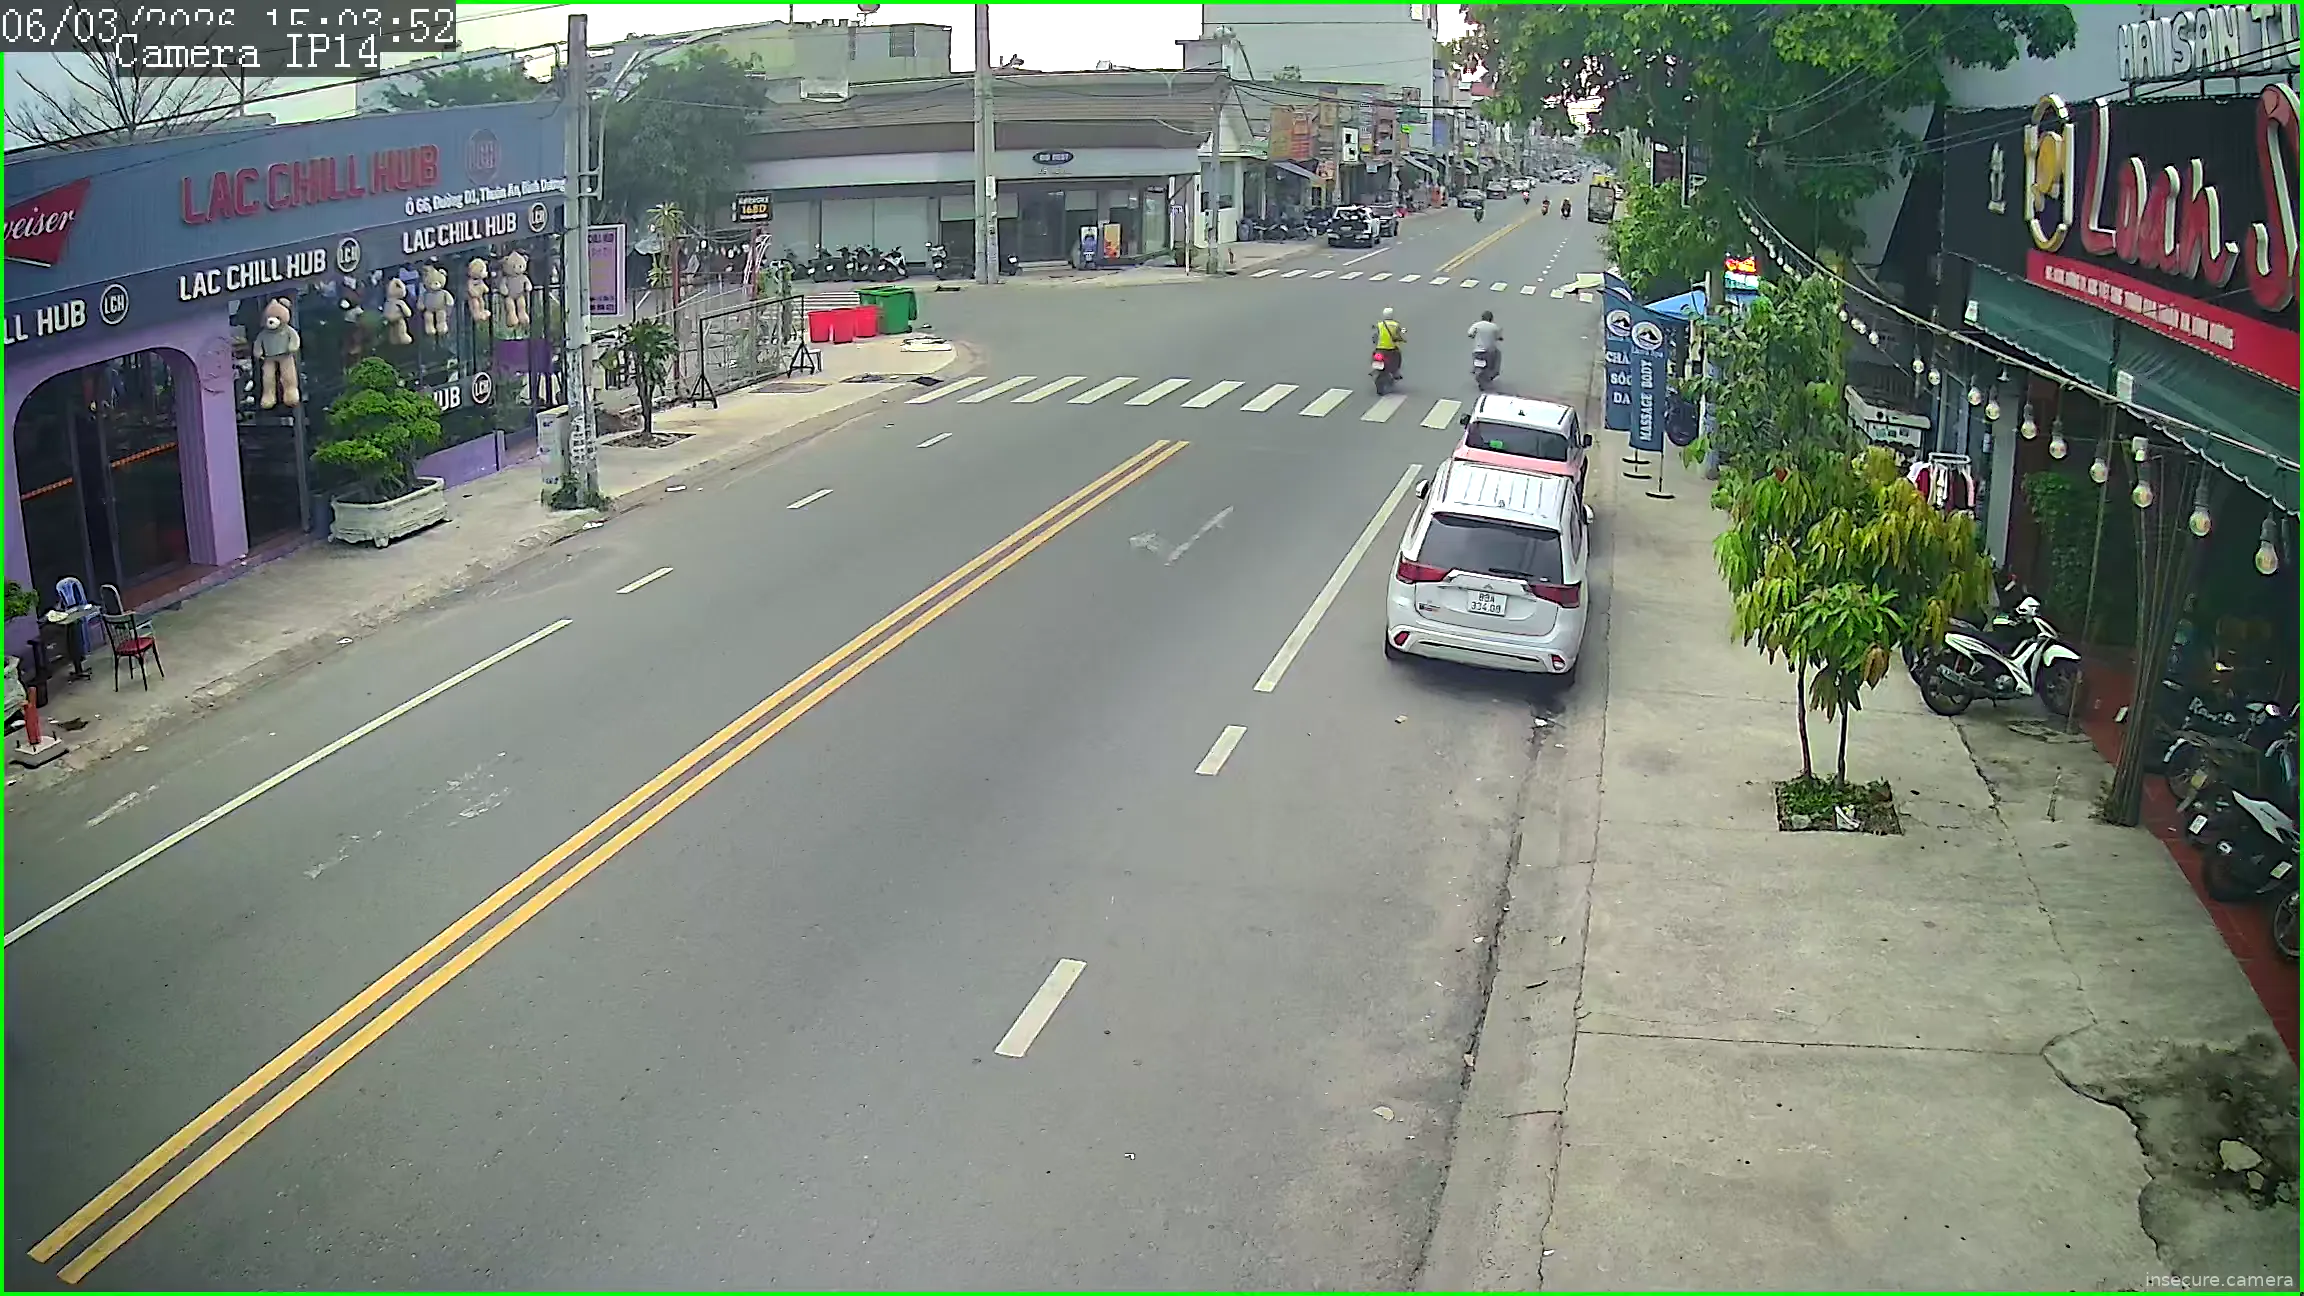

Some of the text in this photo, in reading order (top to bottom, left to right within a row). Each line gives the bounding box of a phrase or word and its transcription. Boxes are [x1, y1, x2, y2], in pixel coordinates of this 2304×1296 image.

[182, 143, 441, 225] LAC CHILL HUB
[402, 211, 518, 255] LAC CHILL HUB
[179, 248, 327, 301] LAC CHILL HUB
[37, 299, 87, 337] HUB
[103, 294, 125, 315] LCH
[1639, 359, 1654, 441] MASSAGE BODY
